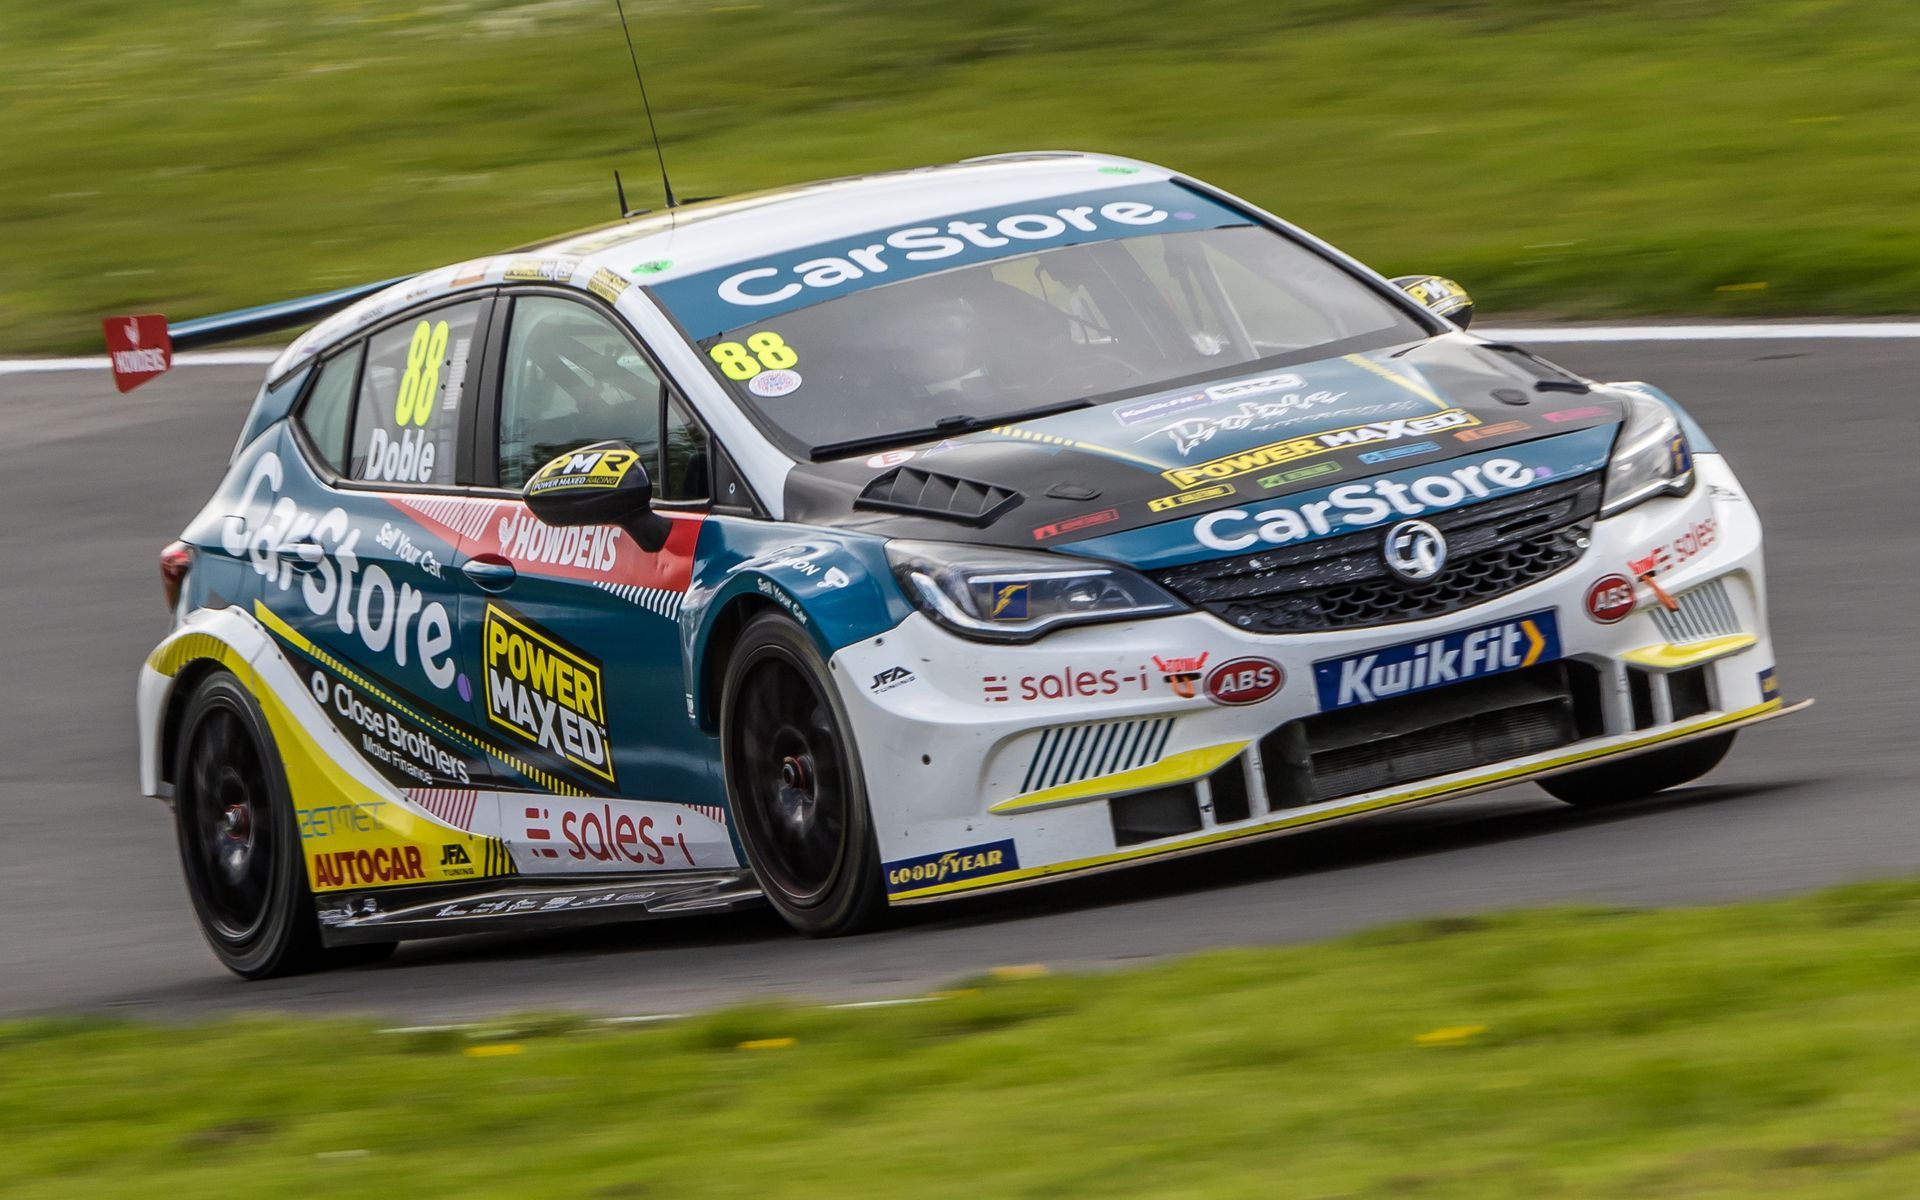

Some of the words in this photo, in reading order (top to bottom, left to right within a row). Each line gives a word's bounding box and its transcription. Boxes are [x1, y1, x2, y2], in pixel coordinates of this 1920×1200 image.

[395, 321, 449, 426] 88
[710, 331, 798, 380] 88
[364, 428, 435, 483] Doble
[541, 453, 631, 477] PMR
[1180, 439, 1323, 485] POWER
[1319, 413, 1468, 447] MAXED
[533, 478, 560, 491] POWER
[559, 476, 586, 486] MAXED
[376, 522, 402, 550] Sell
[395, 533, 422, 566] Your
[510, 516, 622, 572] HOWDENS
[1592, 582, 1632, 613] ABS
[489, 618, 597, 721] POWER
[870, 665, 913, 690] JFA
[1020, 664, 1148, 701] sales-i
[1216, 666, 1275, 696] ABS
[1337, 622, 1522, 706] KwikFit
[334, 683, 386, 738] Close
[385, 712, 470, 785] Brothers
[490, 668, 604, 766] MAXED
[362, 732, 392, 763] Motor
[390, 749, 434, 786] Finance
[440, 843, 472, 866] JFA
[561, 803, 696, 866] sales-i
[314, 845, 426, 888] AUTOCAR
[889, 849, 1003, 885] GOODYEAR
